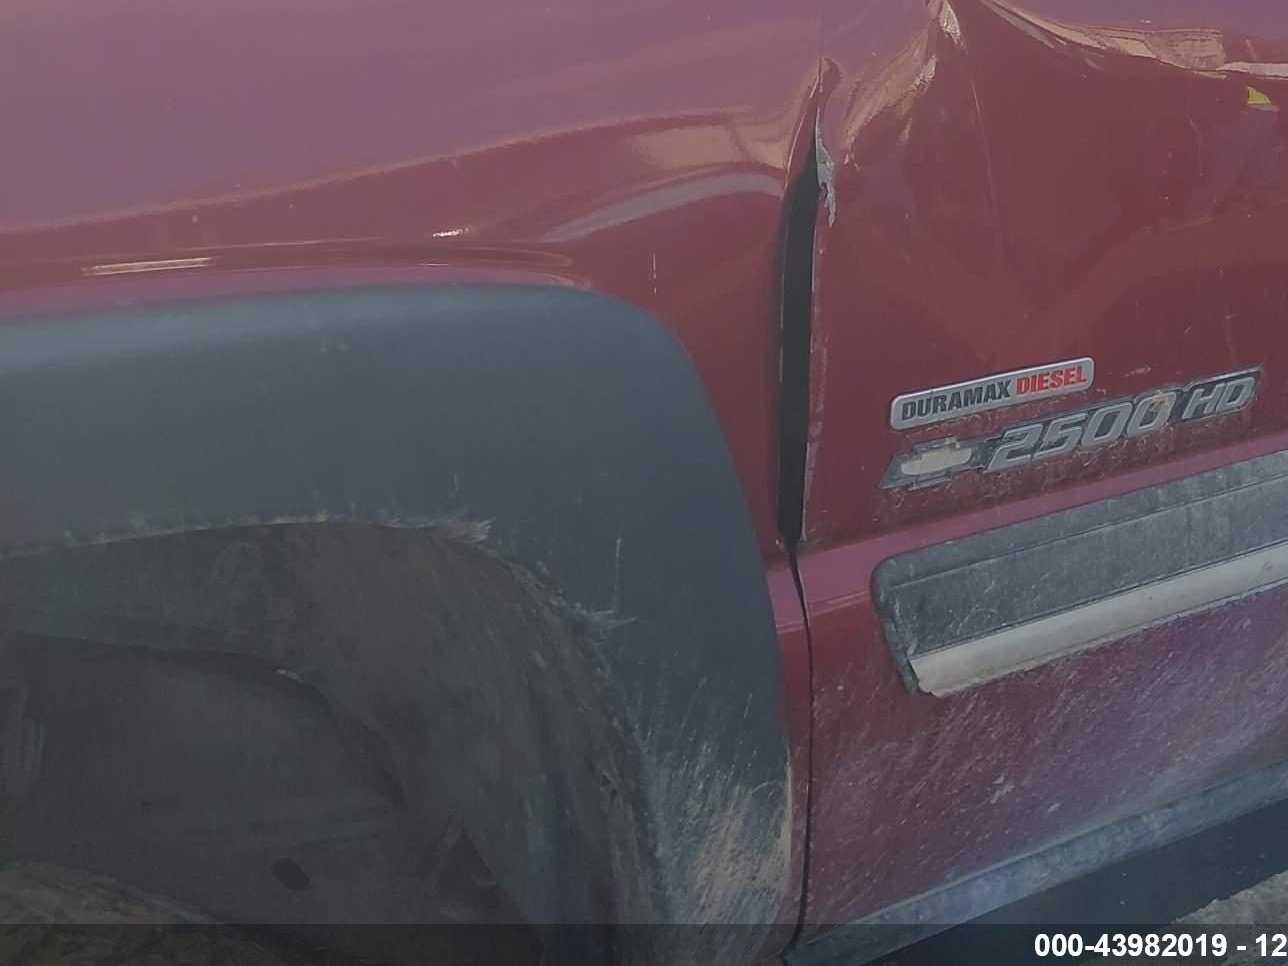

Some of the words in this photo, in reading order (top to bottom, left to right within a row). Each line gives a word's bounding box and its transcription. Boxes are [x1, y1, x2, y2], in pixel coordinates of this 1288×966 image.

[901, 380, 1011, 421] DURAMAX
[1015, 366, 1088, 396] DIESEL
[986, 388, 1178, 473] 2500
[1181, 375, 1258, 419] HD
